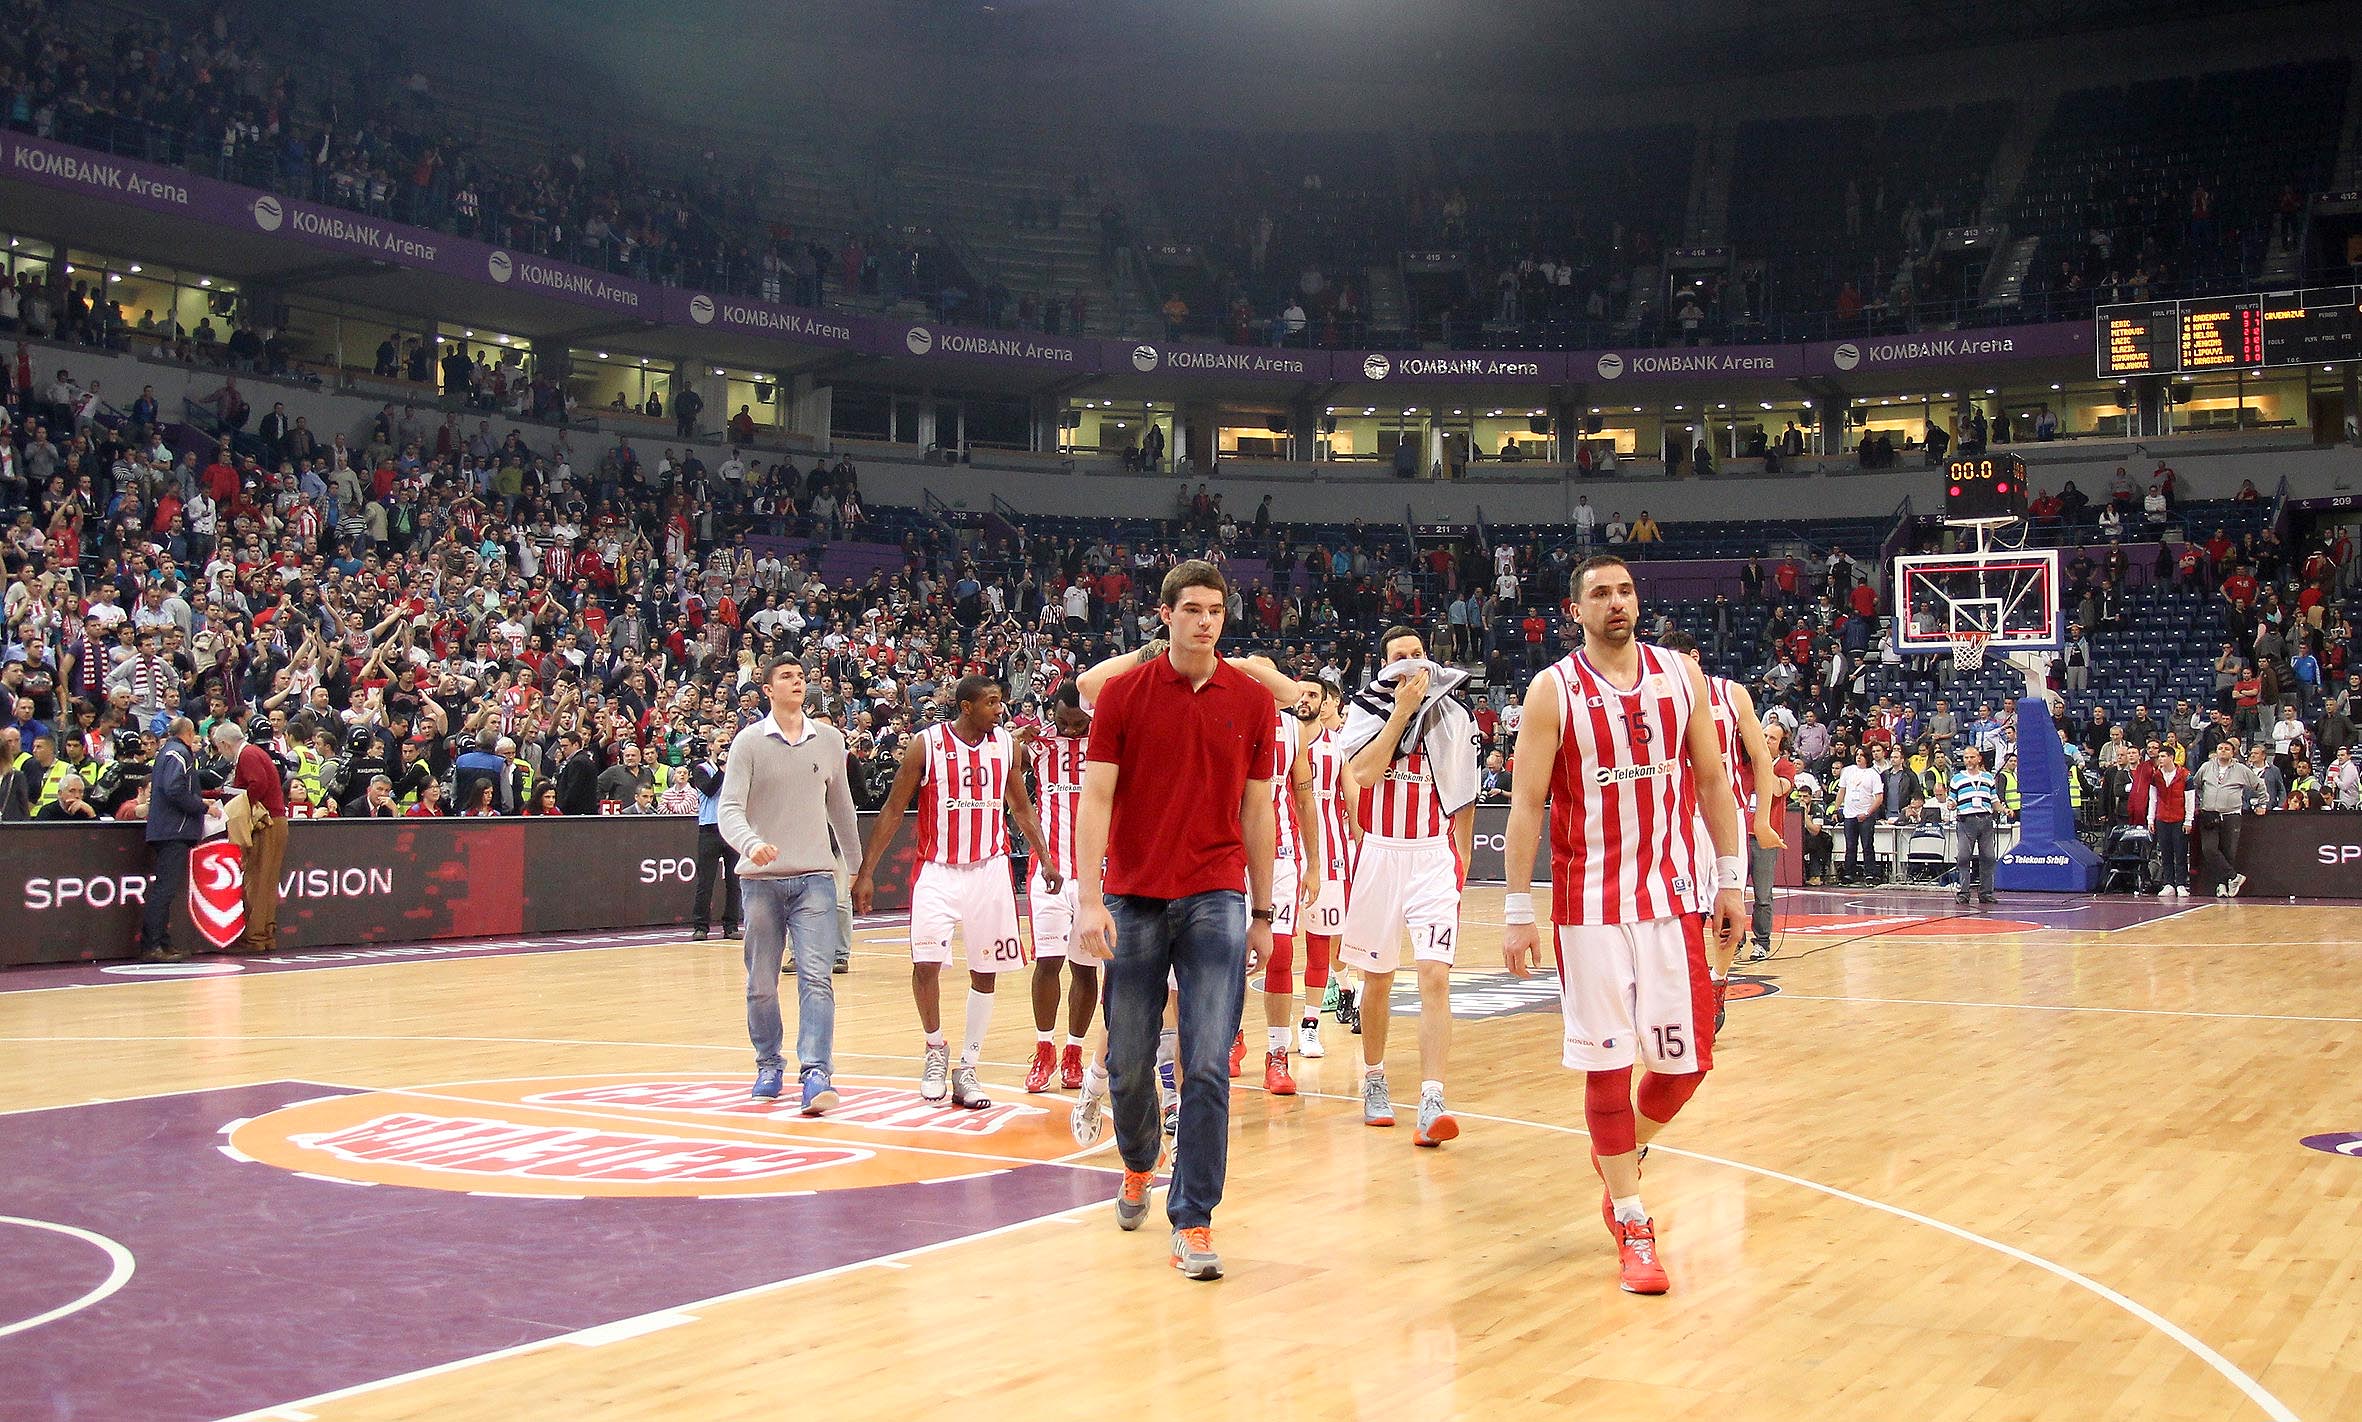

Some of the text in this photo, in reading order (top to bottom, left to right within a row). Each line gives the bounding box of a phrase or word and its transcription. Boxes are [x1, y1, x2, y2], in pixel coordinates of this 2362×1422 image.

[15, 146, 188, 204] KOMBANK Arena
[293, 211, 433, 260] KOMBANK Arena
[521, 264, 638, 306] KOMBANK Arena
[723, 306, 850, 340] KOMBANK Arena
[941, 336, 1073, 361] KOMBANK Arena
[1869, 337, 2014, 360] KOMBANK Arena
[2111, 337, 2131, 346] LAZIC
[1167, 353, 1304, 373] KOMBANK Arena
[1399, 360, 1538, 375] KOMBANK Arena
[1632, 354, 1775, 374] KOMBANK Arena
[1951, 460, 1992, 481] 00.0
[2332, 497, 2351, 506] 209
[1435, 525, 1450, 533] 211
[1617, 709, 1653, 748] 15
[1062, 751, 1086, 771] 22
[963, 766, 988, 787] 20
[1394, 771, 1424, 783] Telekom
[1613, 765, 1656, 781] Telekom
[1057, 784, 1083, 792] Telekom
[957, 800, 986, 808] Telekom
[2015, 855, 2069, 866] Telekom Srbija
[278, 868, 392, 898] VISION
[1321, 908, 1339, 927] 10
[1429, 923, 1452, 951] 14
[994, 938, 1018, 961] 20
[1567, 1037, 1594, 1047] HONDA
[1651, 1024, 1686, 1060] 15
[314, 1115, 862, 1180] CEDEVITA
